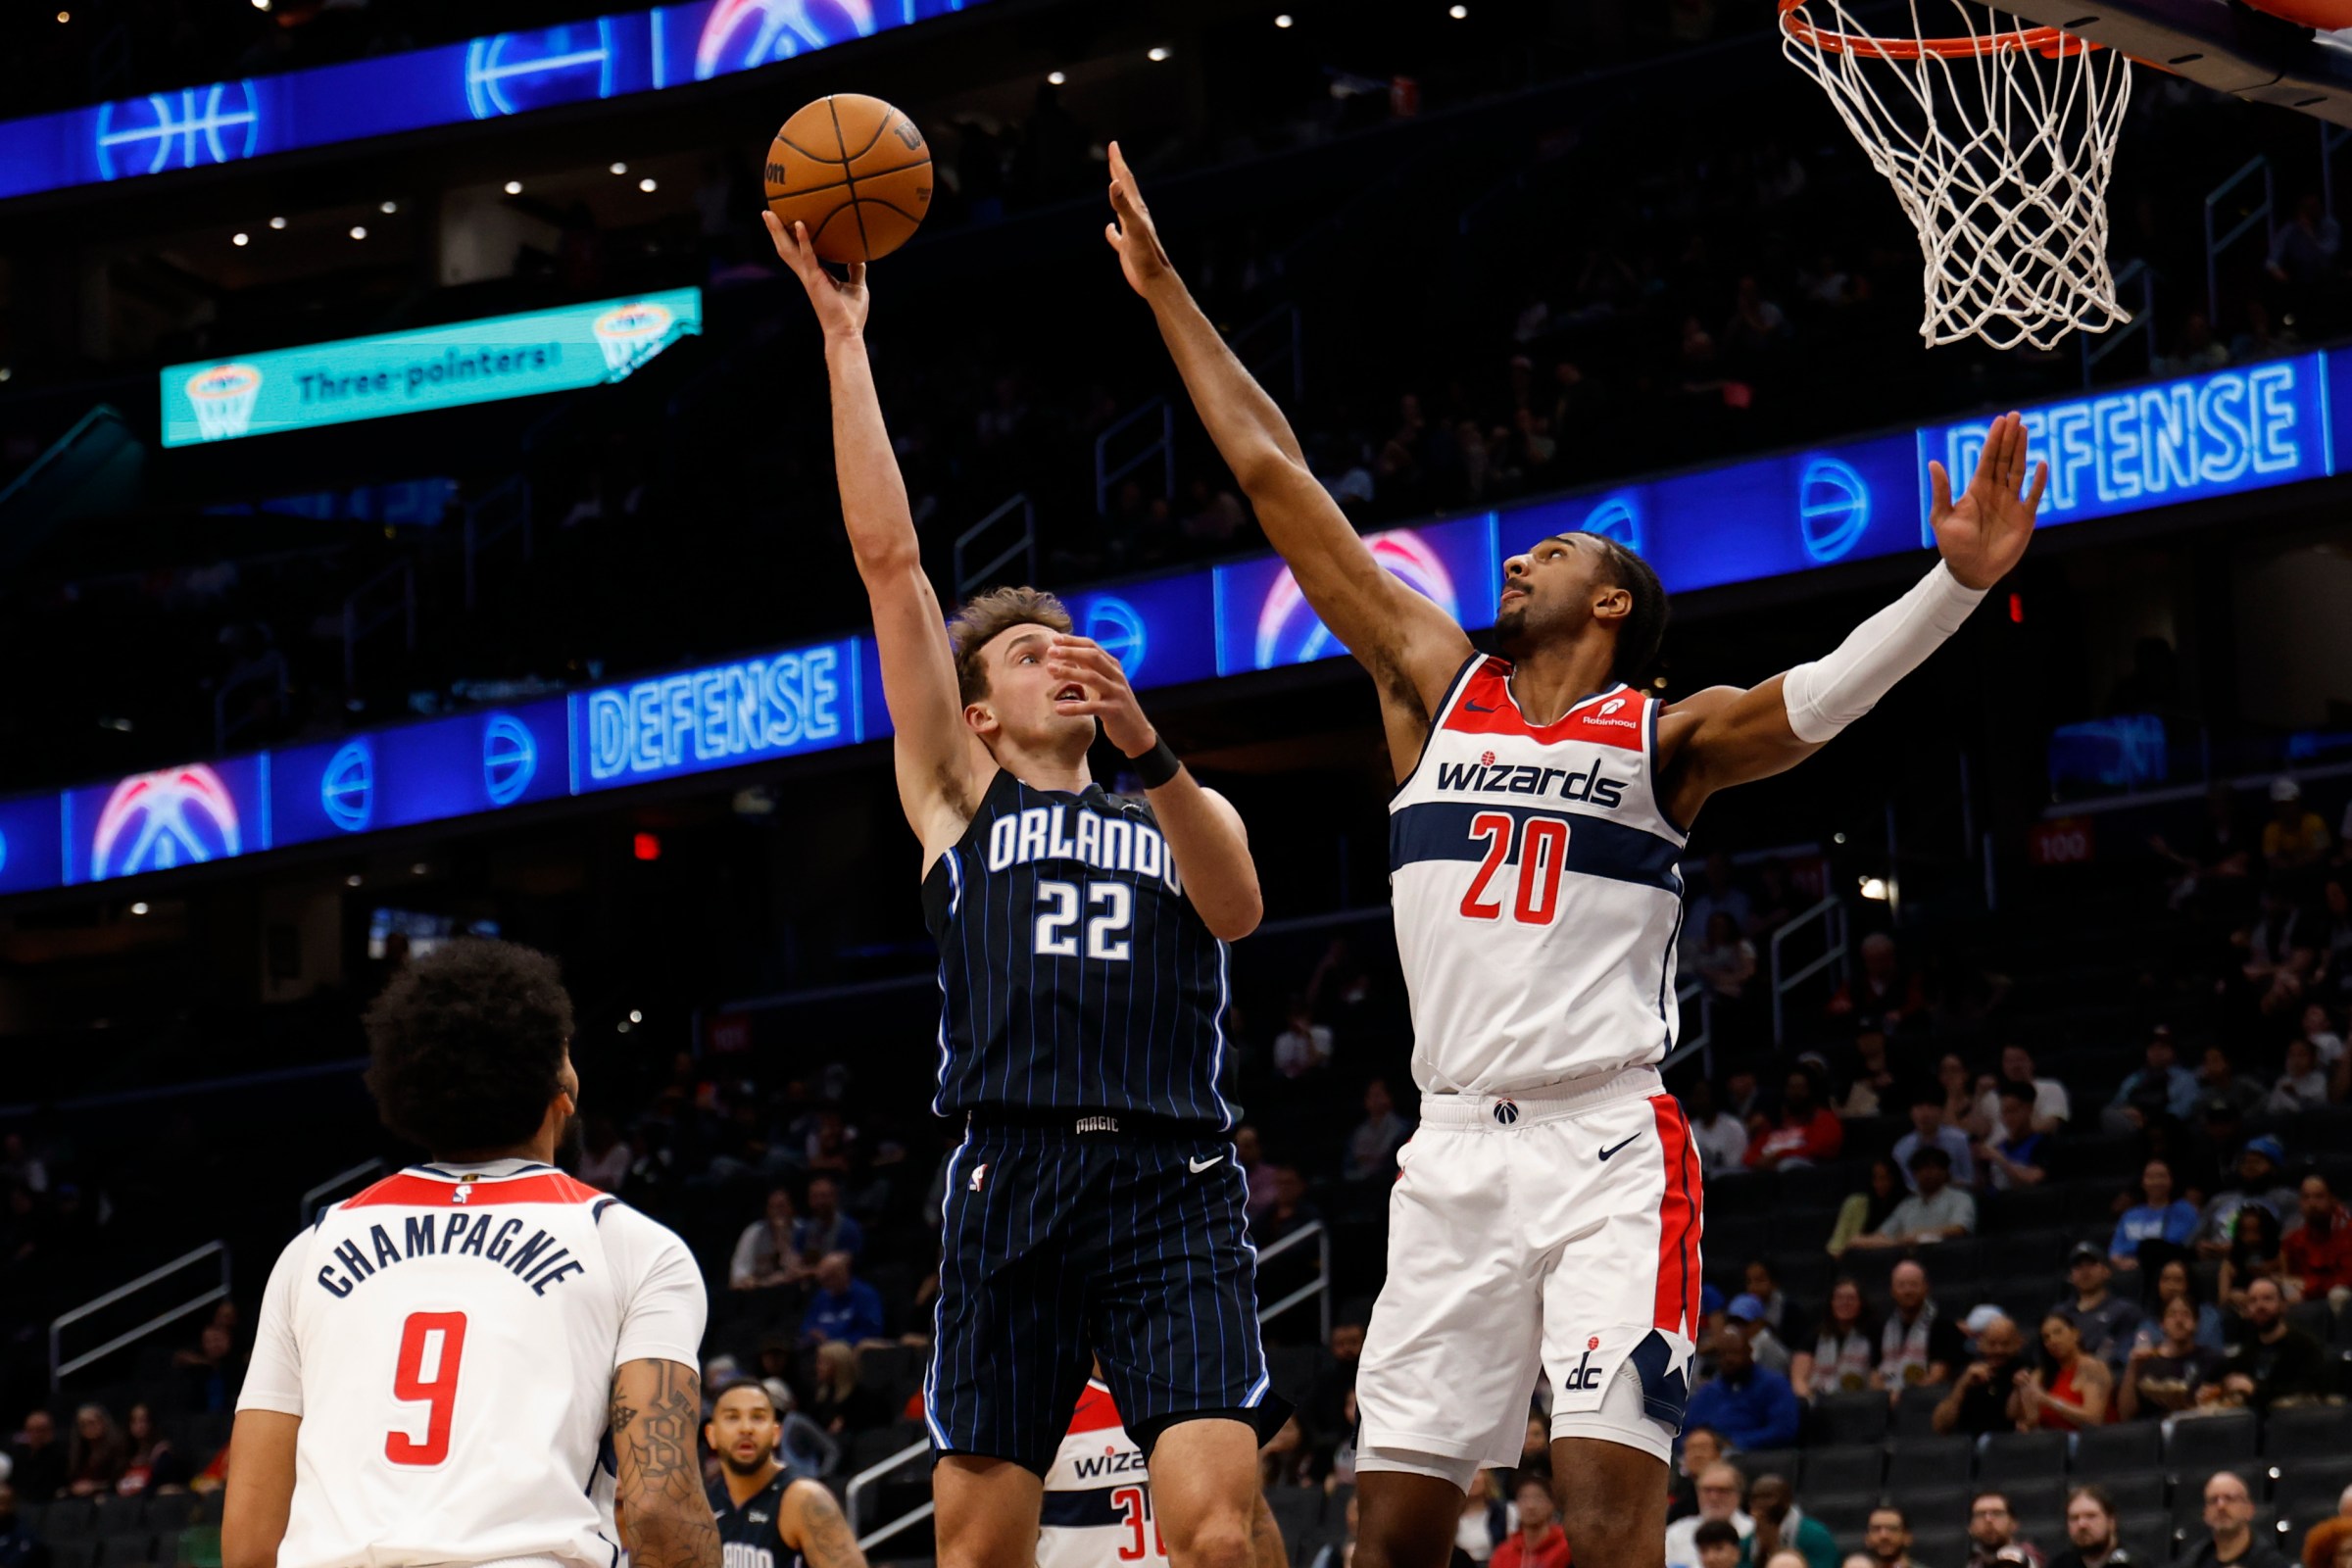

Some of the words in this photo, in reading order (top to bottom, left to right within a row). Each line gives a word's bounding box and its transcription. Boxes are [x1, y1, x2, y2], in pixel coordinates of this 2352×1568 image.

[588, 645, 839, 779] DEFENSE
[1583, 715, 1637, 729] Robinhood
[1437, 752, 1631, 809] wizards
[1459, 811, 1570, 925] 20
[2040, 831, 2086, 862] 100
[1032, 881, 1131, 961] 22
[1076, 1115, 1119, 1135] MAGIC
[317, 1212, 585, 1299] CHAMPAGNIE
[384, 1310, 467, 1466] 9
[1565, 1350, 1602, 1390] dc
